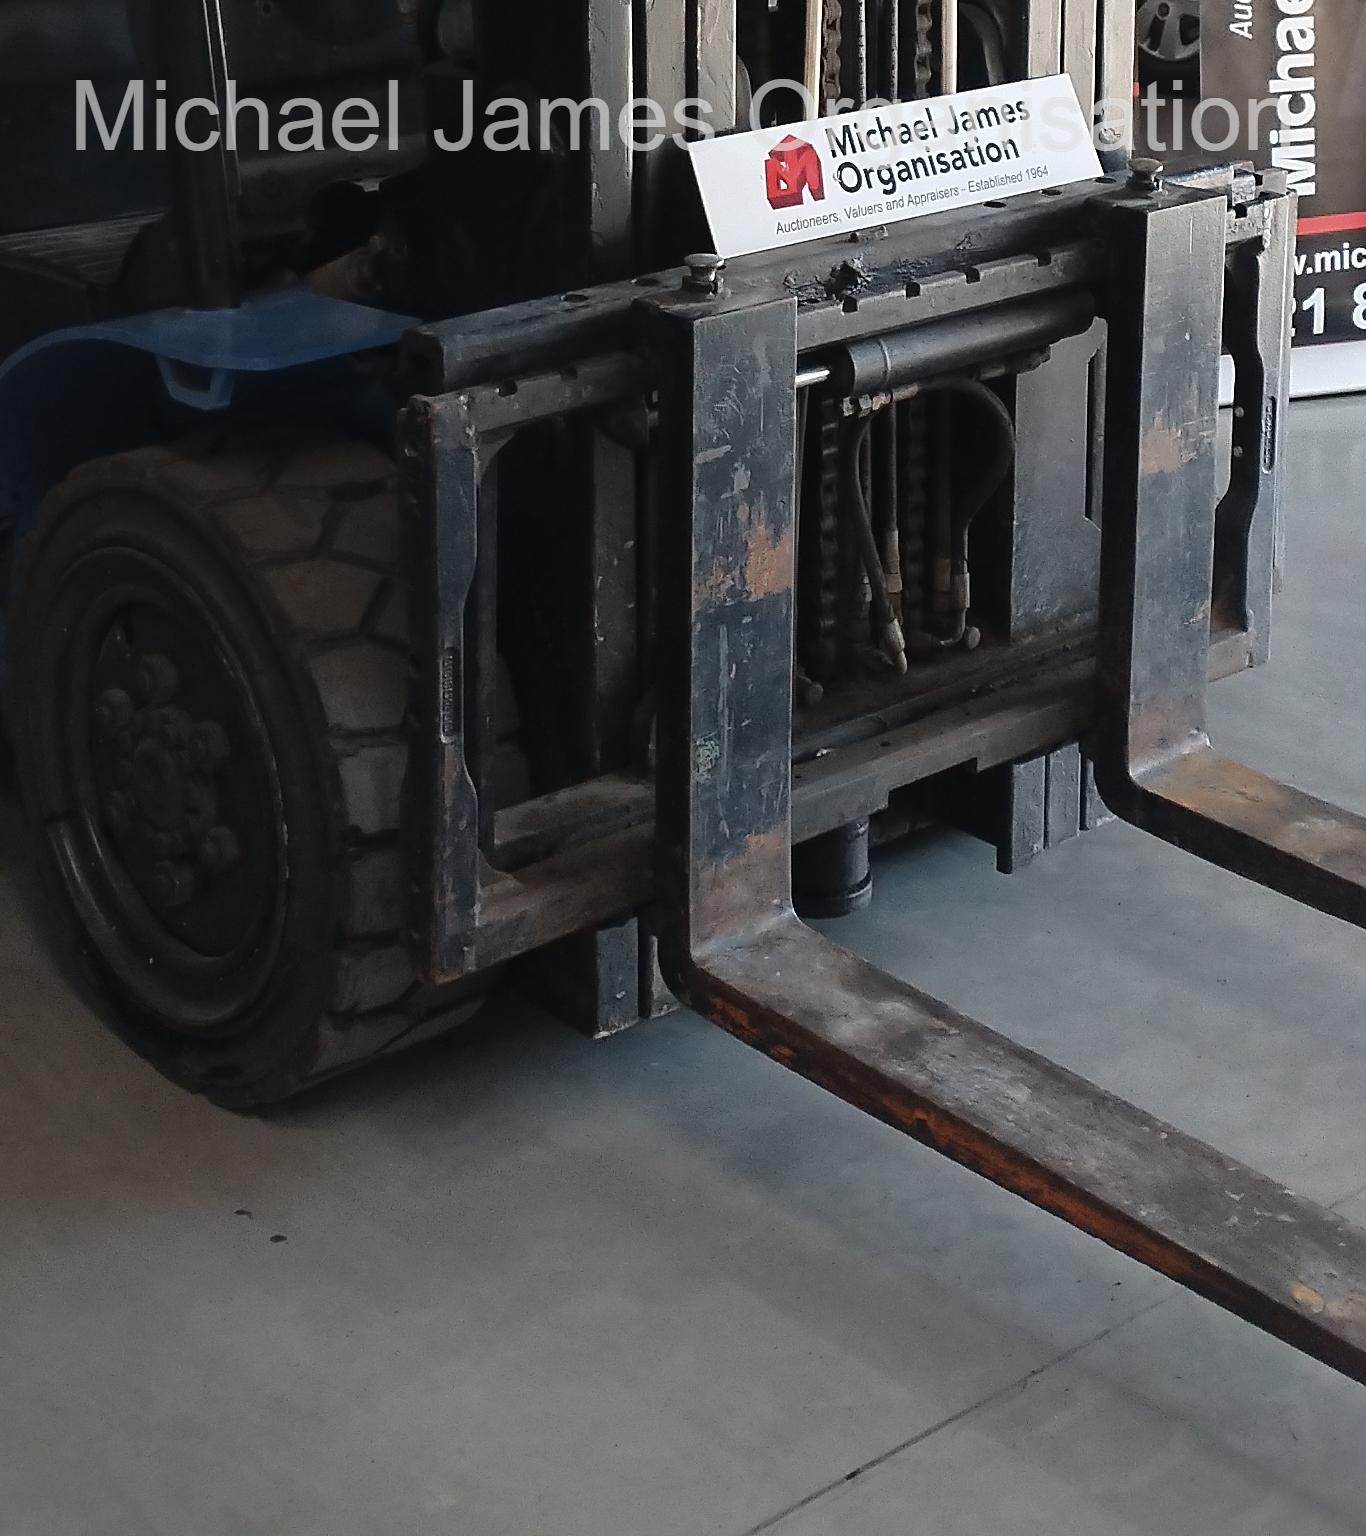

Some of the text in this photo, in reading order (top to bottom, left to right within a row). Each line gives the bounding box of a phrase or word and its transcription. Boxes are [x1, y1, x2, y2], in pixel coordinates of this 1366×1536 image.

[825, 100, 1030, 158] Michael James
[837, 137, 1021, 195] Organisation
[776, 211, 842, 235] Auctioneers,
[844, 203, 883, 220] Valuers
[886, 196, 905, 211] and
[907, 187, 959, 210] Appraisers
[968, 172, 1023, 194] Established
[1025, 165, 1049, 182] 1964
